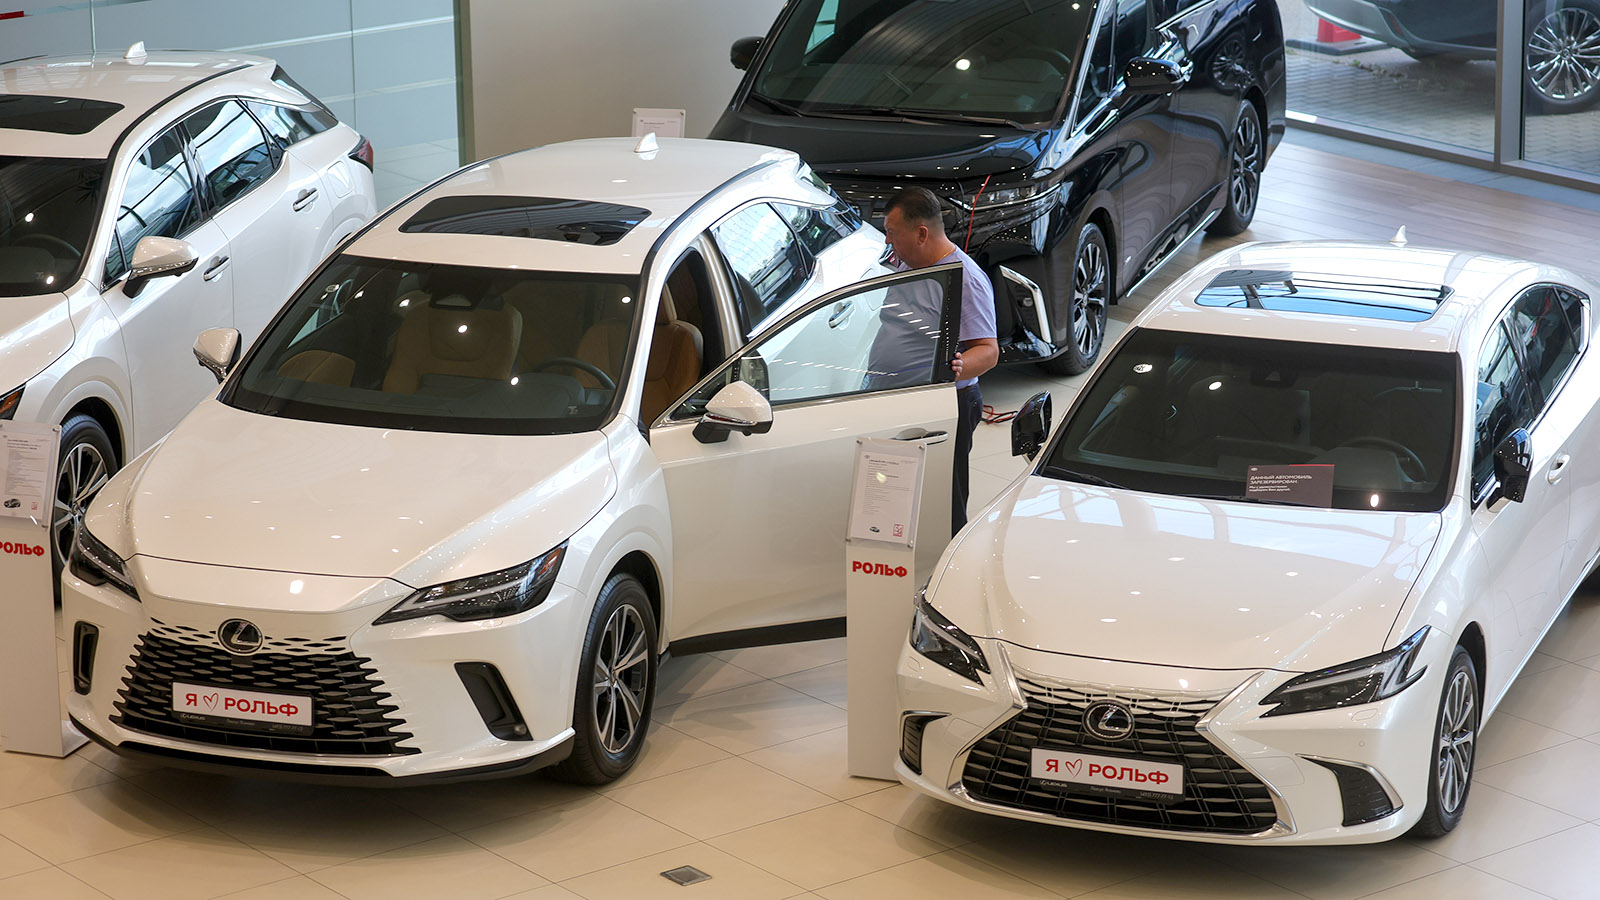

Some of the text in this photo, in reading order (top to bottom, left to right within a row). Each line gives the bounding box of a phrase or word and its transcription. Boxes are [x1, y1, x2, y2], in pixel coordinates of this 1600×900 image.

[852, 560, 908, 578] РОЛЬФ
[185, 693, 299, 717] Я РОЛЬФ
[1045, 758, 1169, 785] Я РОЛЬФ
